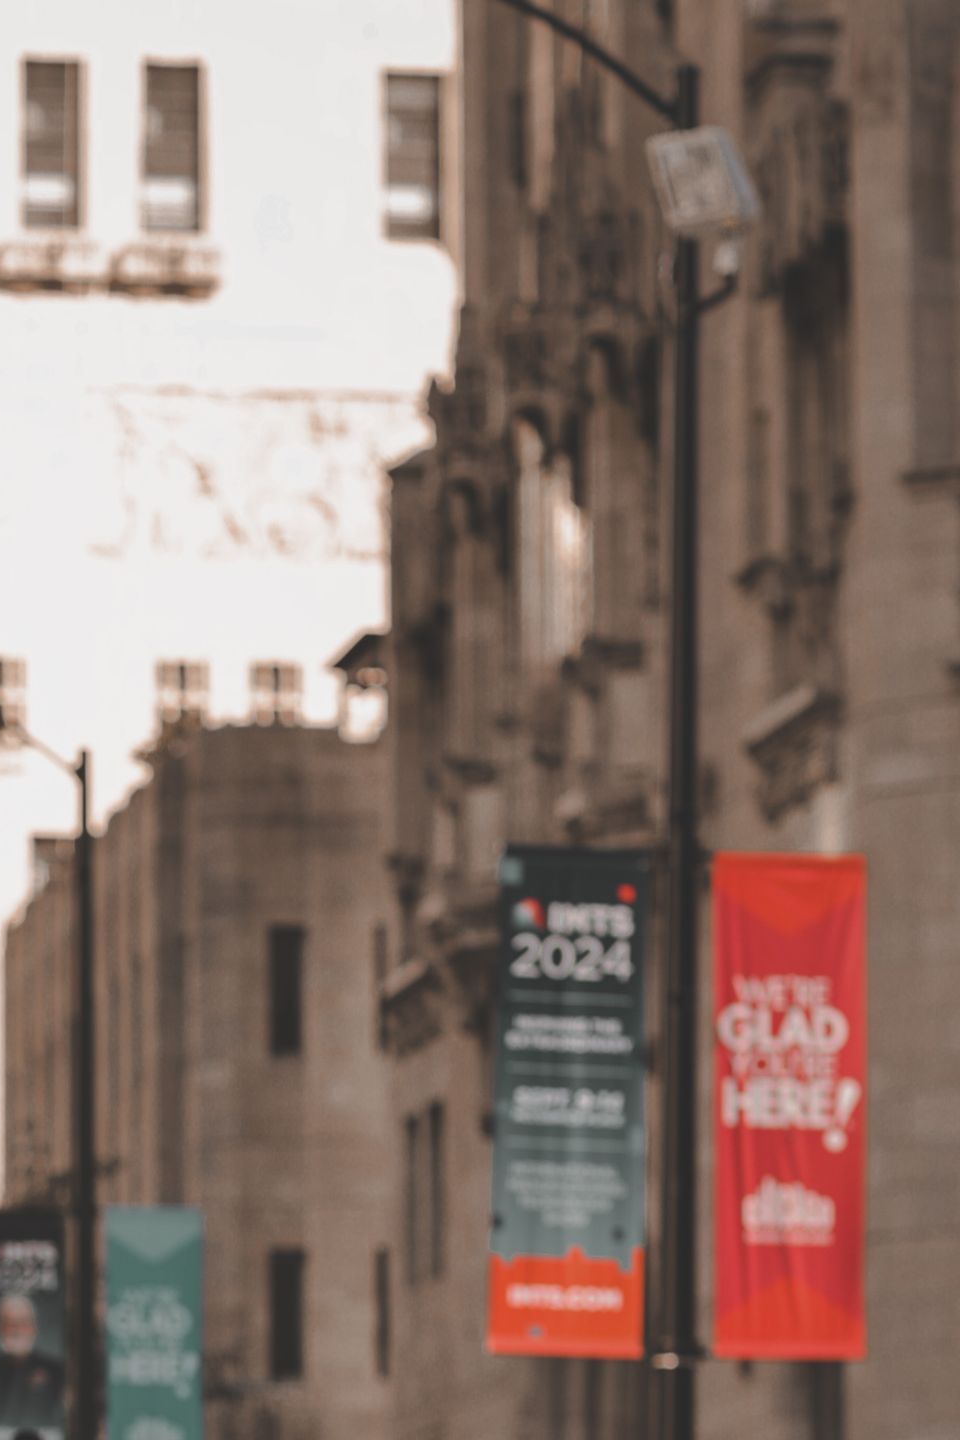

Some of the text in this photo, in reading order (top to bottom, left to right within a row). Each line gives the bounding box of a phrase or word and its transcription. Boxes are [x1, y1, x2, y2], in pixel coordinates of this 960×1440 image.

[510, 932, 634, 982] 2024
[717, 1002, 850, 1053] GLAD
[721, 1077, 862, 1152] HERE!
